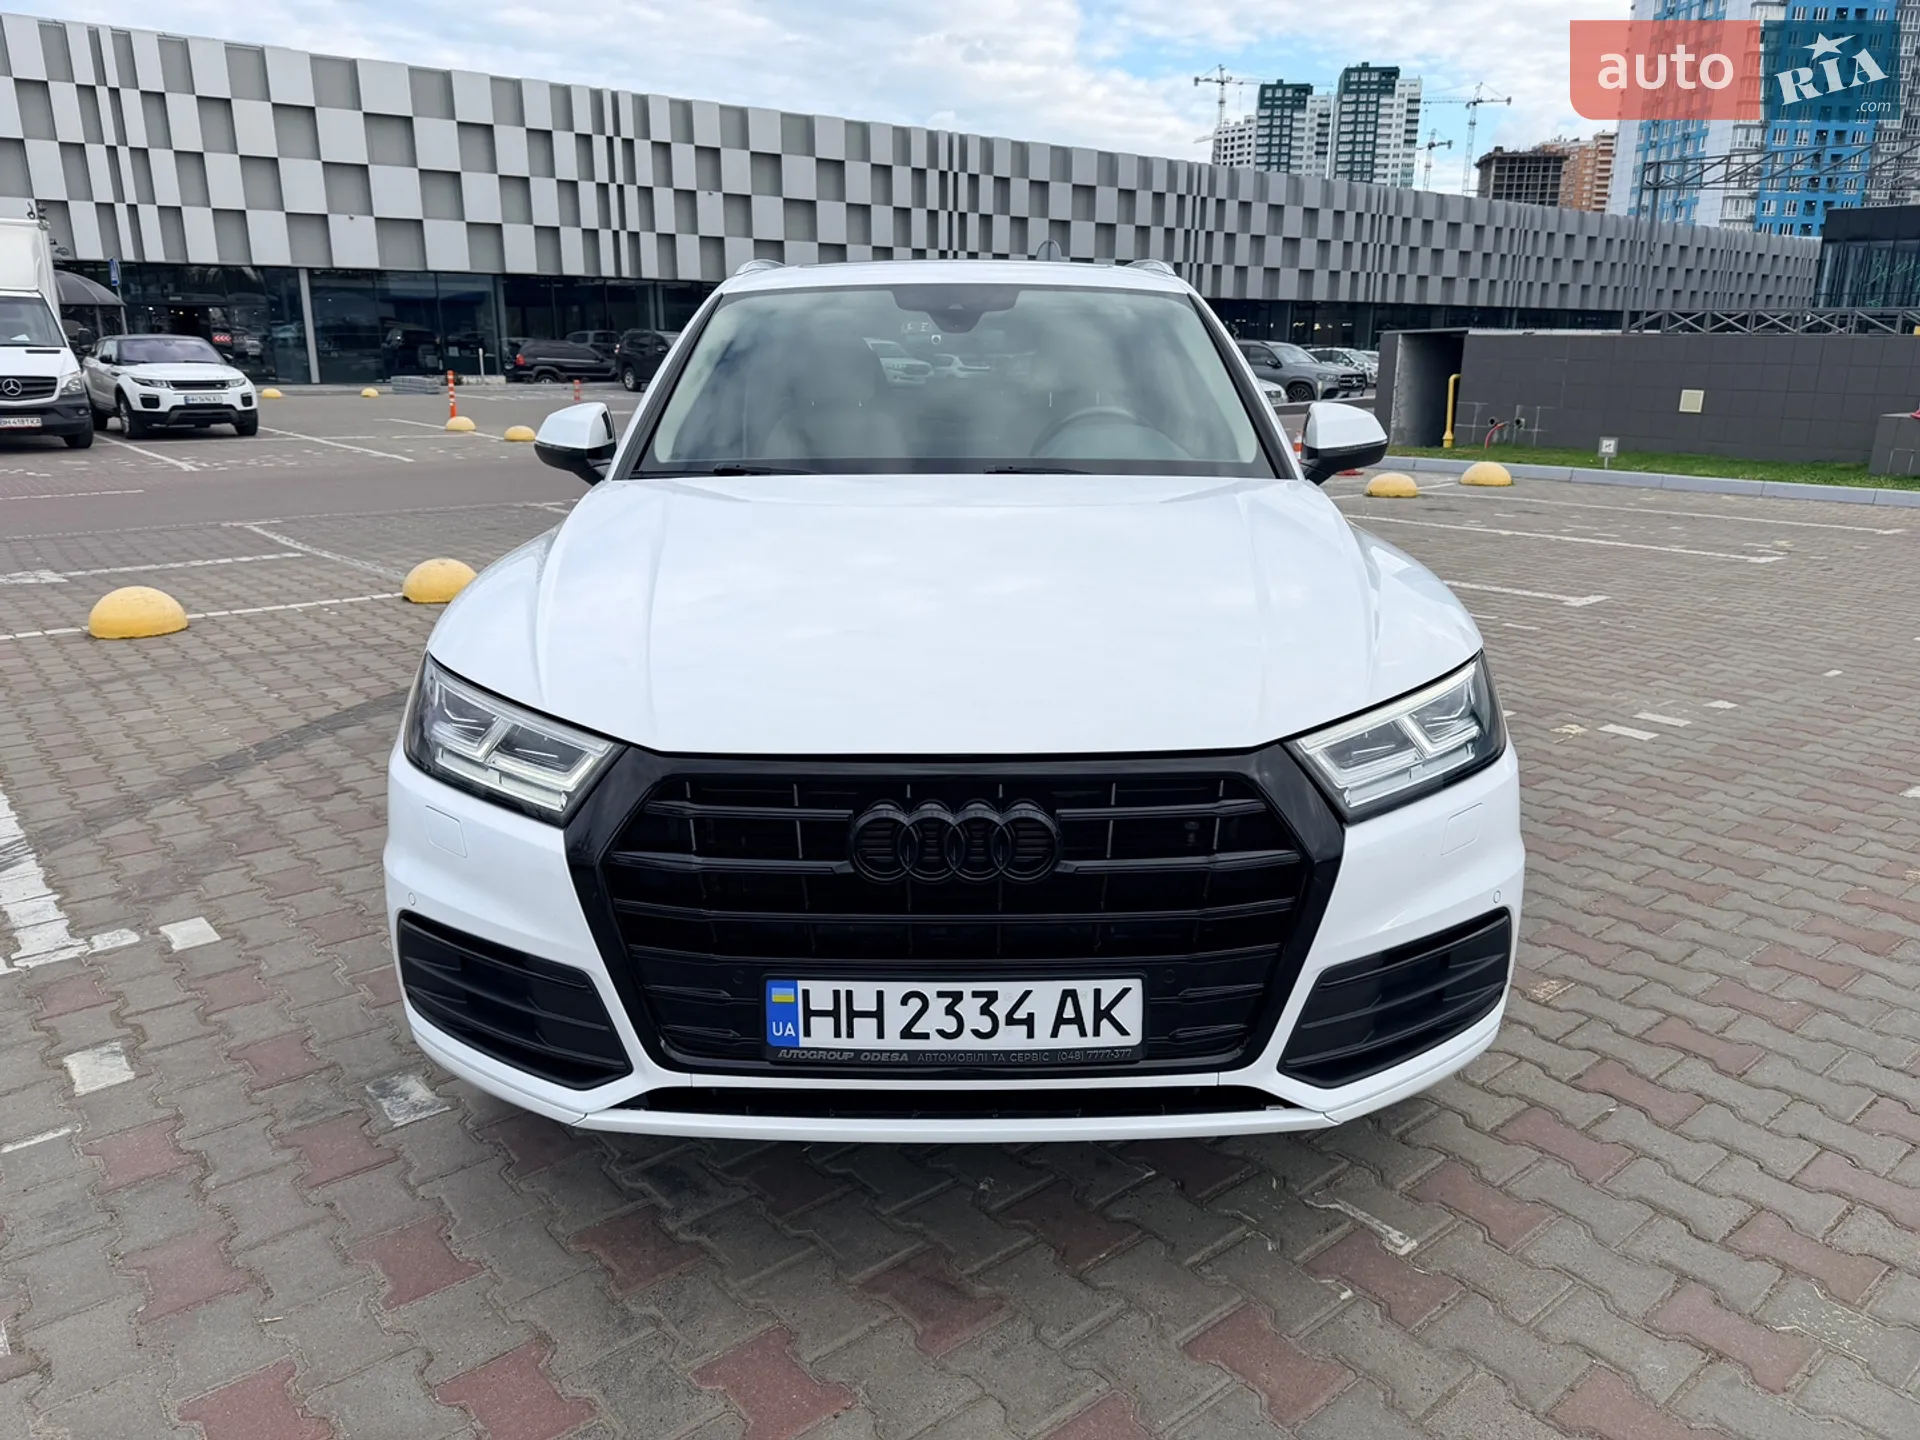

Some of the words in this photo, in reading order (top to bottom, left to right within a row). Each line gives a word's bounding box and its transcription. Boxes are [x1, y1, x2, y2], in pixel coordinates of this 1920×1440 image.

[771, 1021, 796, 1037] UA
[801, 988, 884, 1039] HH
[899, 989, 1036, 1040] 2334
[1050, 986, 1133, 1039] AK
[777, 1049, 854, 1061] AUTOGROUP
[860, 1052, 909, 1062] ODESA
[1057, 1050, 1084, 1062] (048)
[1086, 1049, 1132, 1060] 7777-377
